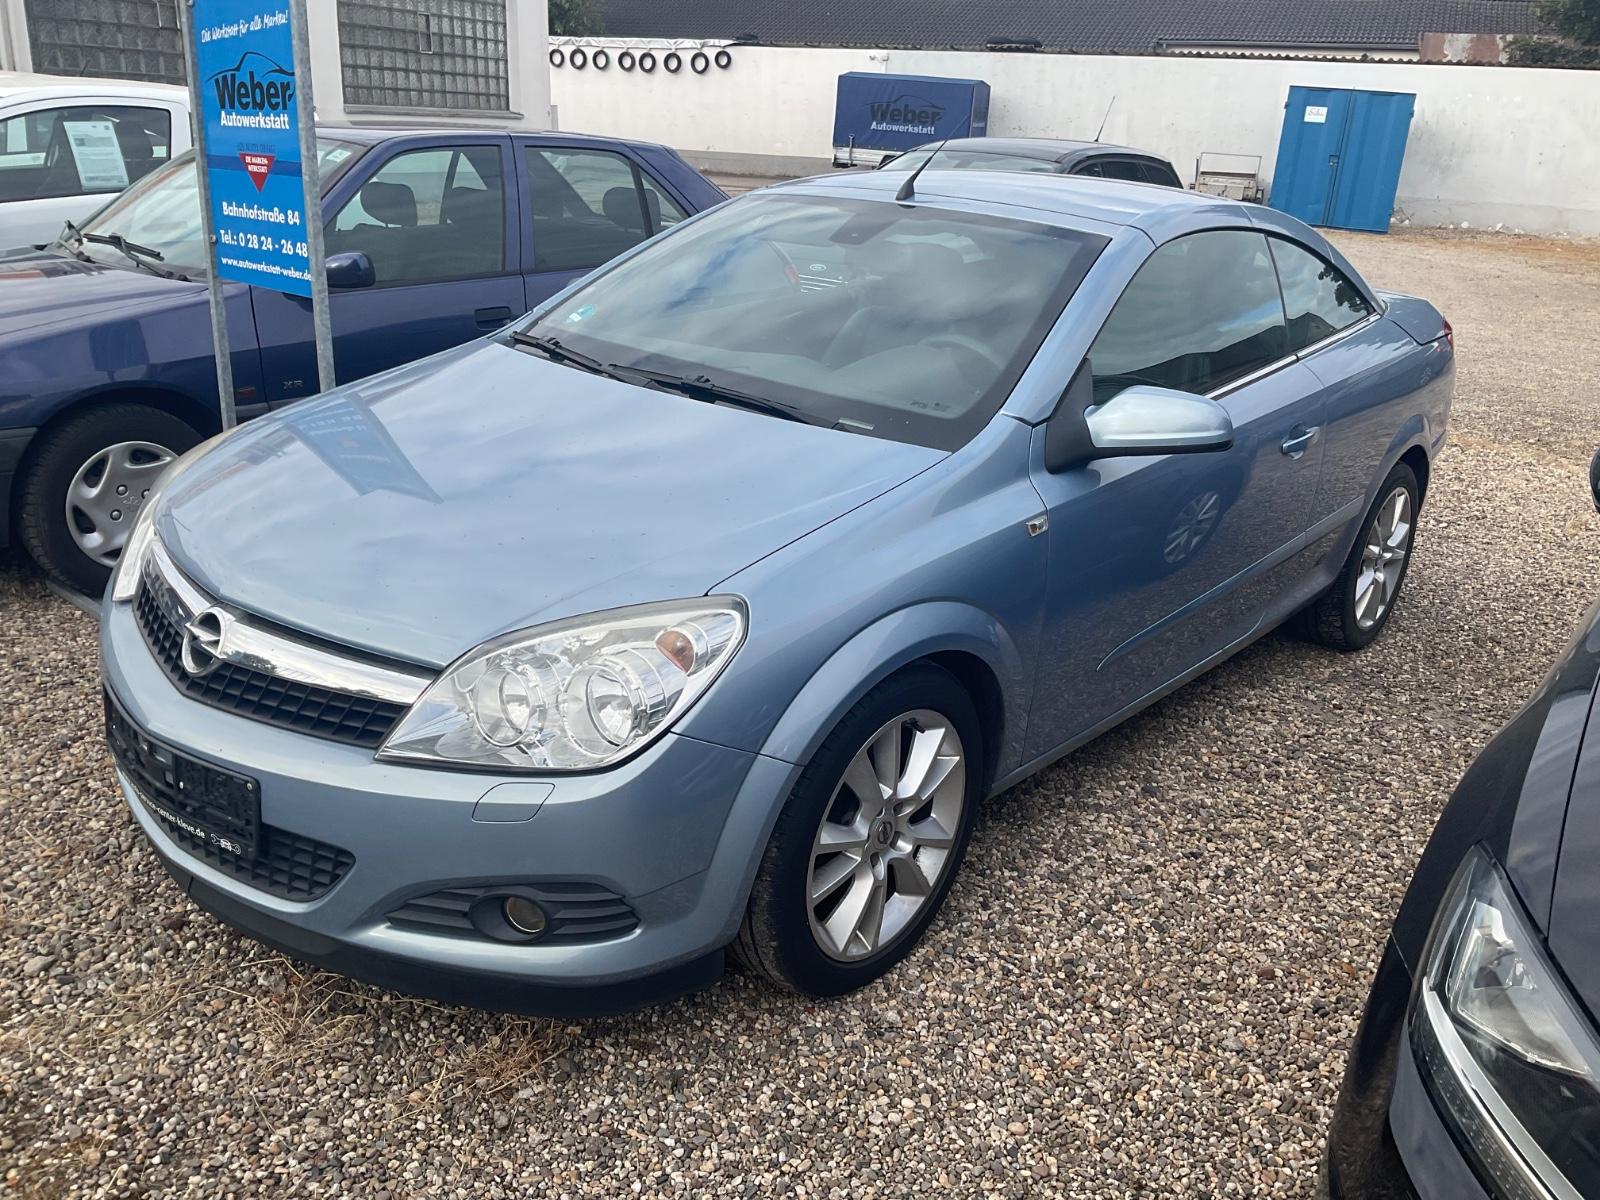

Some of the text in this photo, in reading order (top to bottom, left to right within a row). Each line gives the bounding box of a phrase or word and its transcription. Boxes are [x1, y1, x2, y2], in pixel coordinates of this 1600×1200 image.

[201, 9, 288, 43] Die Werkstatt für alle Marken!
[214, 70, 290, 111] Weber
[220, 111, 289, 129] Autowerkstatt
[869, 103, 941, 125] Weber
[870, 121, 935, 135] Autowerkstatt
[222, 201, 300, 226] Bahnhofstraße 84
[219, 229, 238, 245] Tel.:
[239, 232, 245, 247] 0
[247, 233, 259, 249] 28
[261, 236, 273, 251] 24
[281, 239, 293, 255] 26
[295, 242, 308, 258] 48
[221, 257, 312, 280] www.autowerkstatt-weber.de
